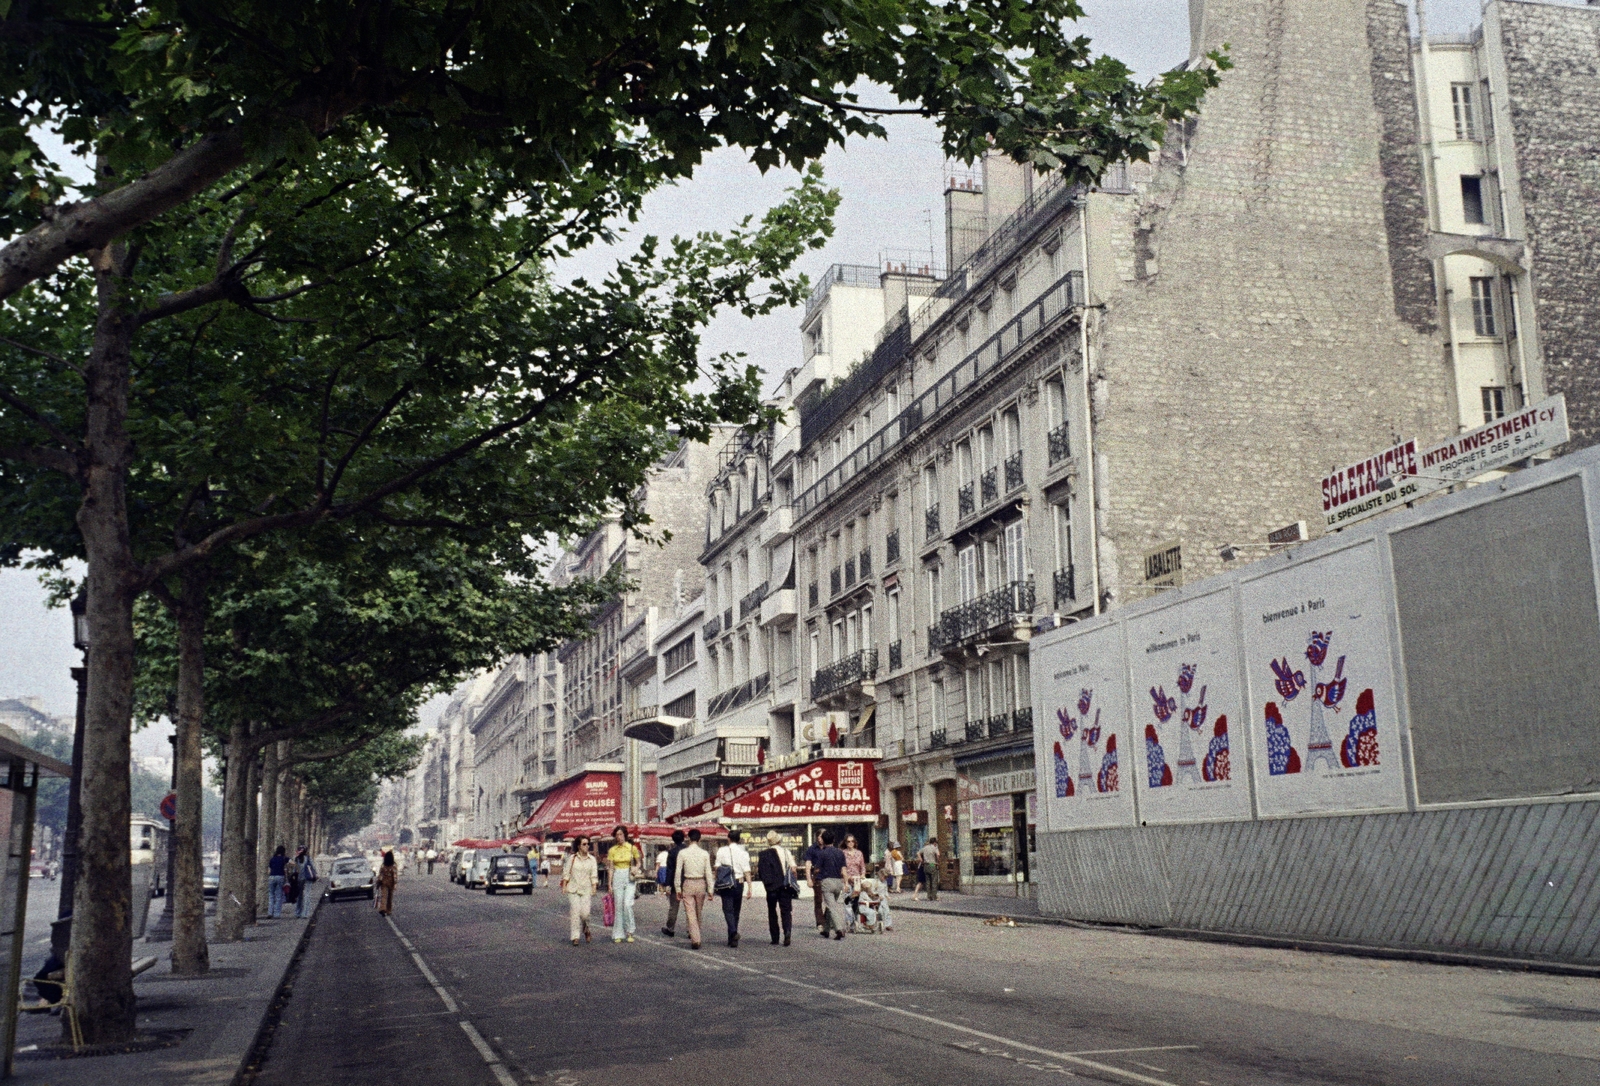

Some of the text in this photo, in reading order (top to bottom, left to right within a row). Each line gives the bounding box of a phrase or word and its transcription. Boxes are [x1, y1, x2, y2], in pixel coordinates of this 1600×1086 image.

[1422, 443, 1458, 469] INTRA
[1459, 409, 1538, 454] INVESTMENT
[1490, 440, 1510, 454] DES
[1321, 440, 1418, 512] SOLETANCHE
[1327, 514, 1336, 525] LE
[1385, 490, 1397, 503] DU
[1400, 483, 1418, 497] SOL
[1144, 544, 1182, 581] LABALETTE
[1262, 597, 1326, 623] bienvenue à Paris
[848, 749, 877, 758] TABAC
[840, 769, 861, 777] STELLA
[1011, 771, 1036, 787] RICHA
[760, 767, 823, 802] TABAC
[815, 780, 833, 788] LE
[840, 776, 861, 785] ARTOIS
[792, 788, 871, 801] MADRIGAL
[570, 798, 616, 808] LE COLISÉE
[732, 801, 872, 813] Bar Glacier Brasserie
[743, 835, 803, 844] TABA BAR
